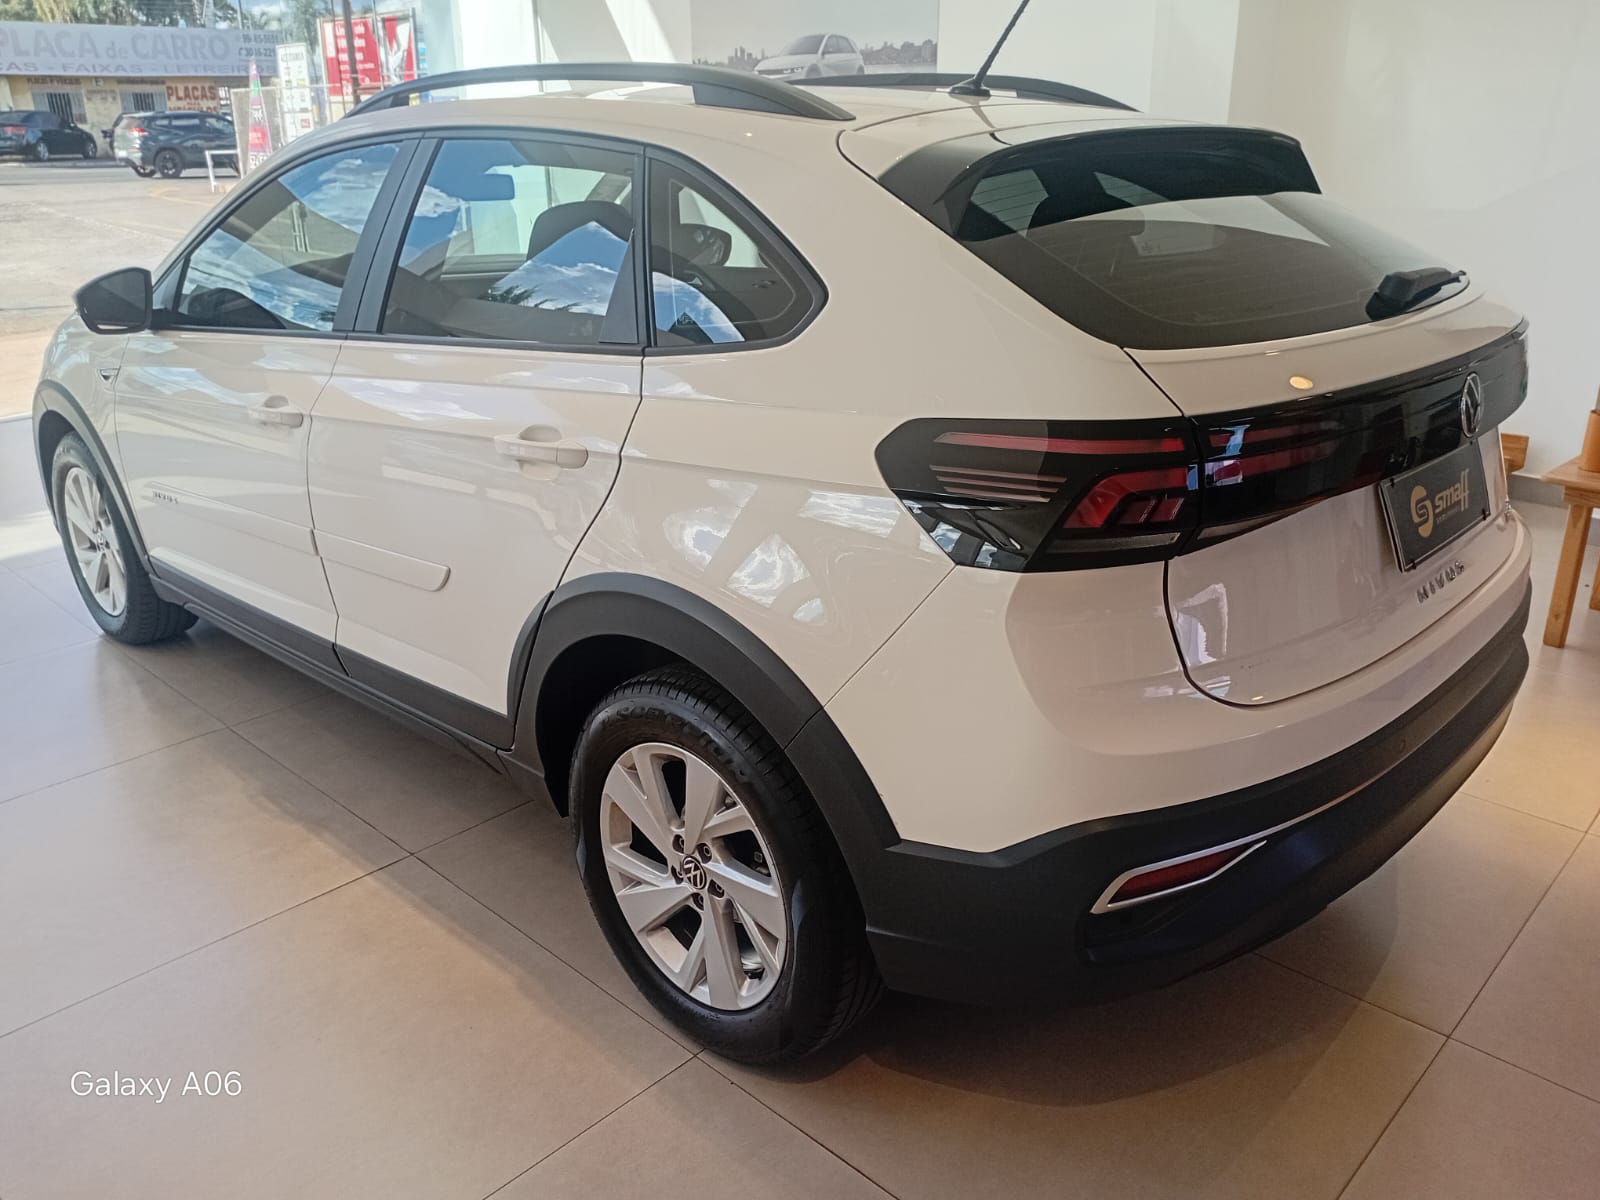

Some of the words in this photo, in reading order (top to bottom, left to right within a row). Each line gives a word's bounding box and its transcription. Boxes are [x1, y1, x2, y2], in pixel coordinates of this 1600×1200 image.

[106, 40, 129, 59] de
[130, 33, 231, 61] CARRO
[61, 63, 143, 73] FAIXAS
[166, 85, 217, 101] PLACAS
[1416, 560, 1465, 603] NIVUS
